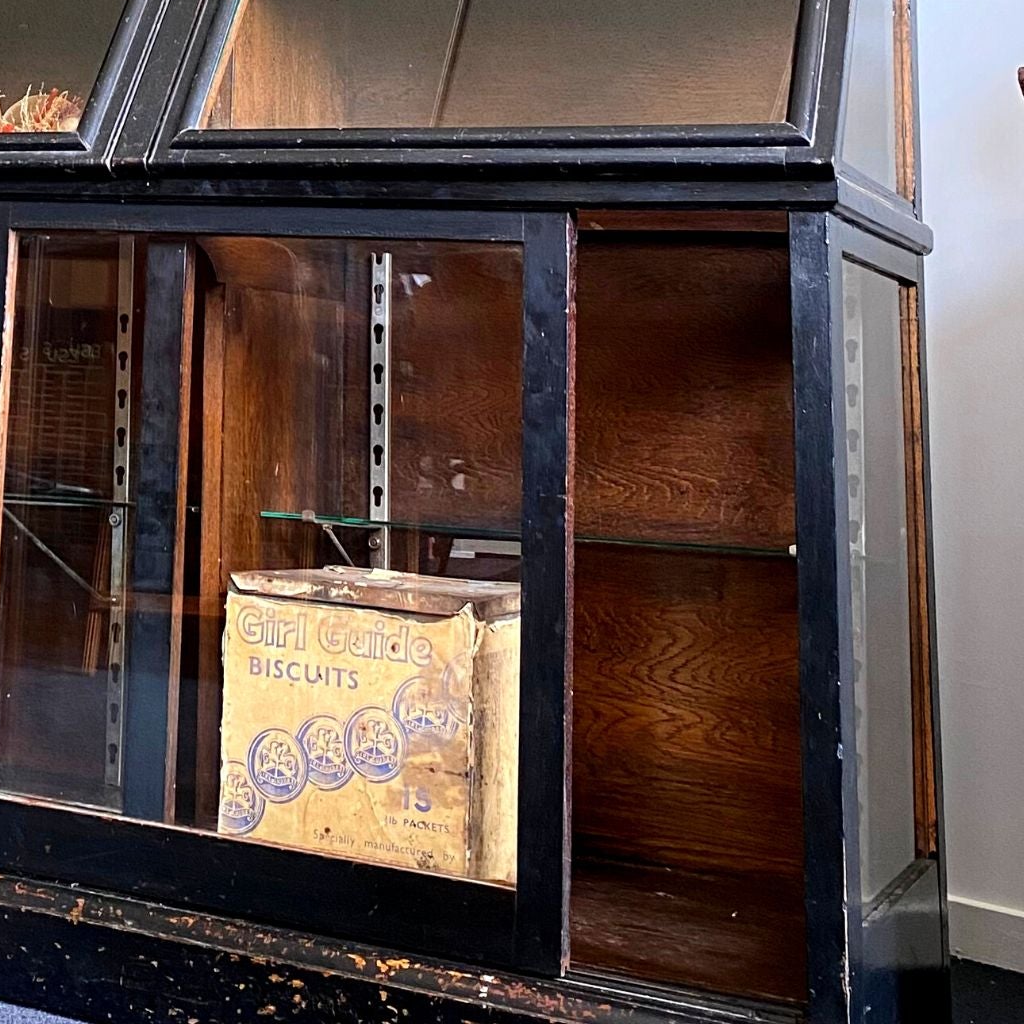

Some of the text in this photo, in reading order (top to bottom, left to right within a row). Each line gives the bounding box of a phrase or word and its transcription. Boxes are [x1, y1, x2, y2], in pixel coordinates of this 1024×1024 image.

[237, 607, 433, 667] Girl Guide
[249, 656, 359, 690] BISCUITS
[403, 818, 451, 834] PACKETS
